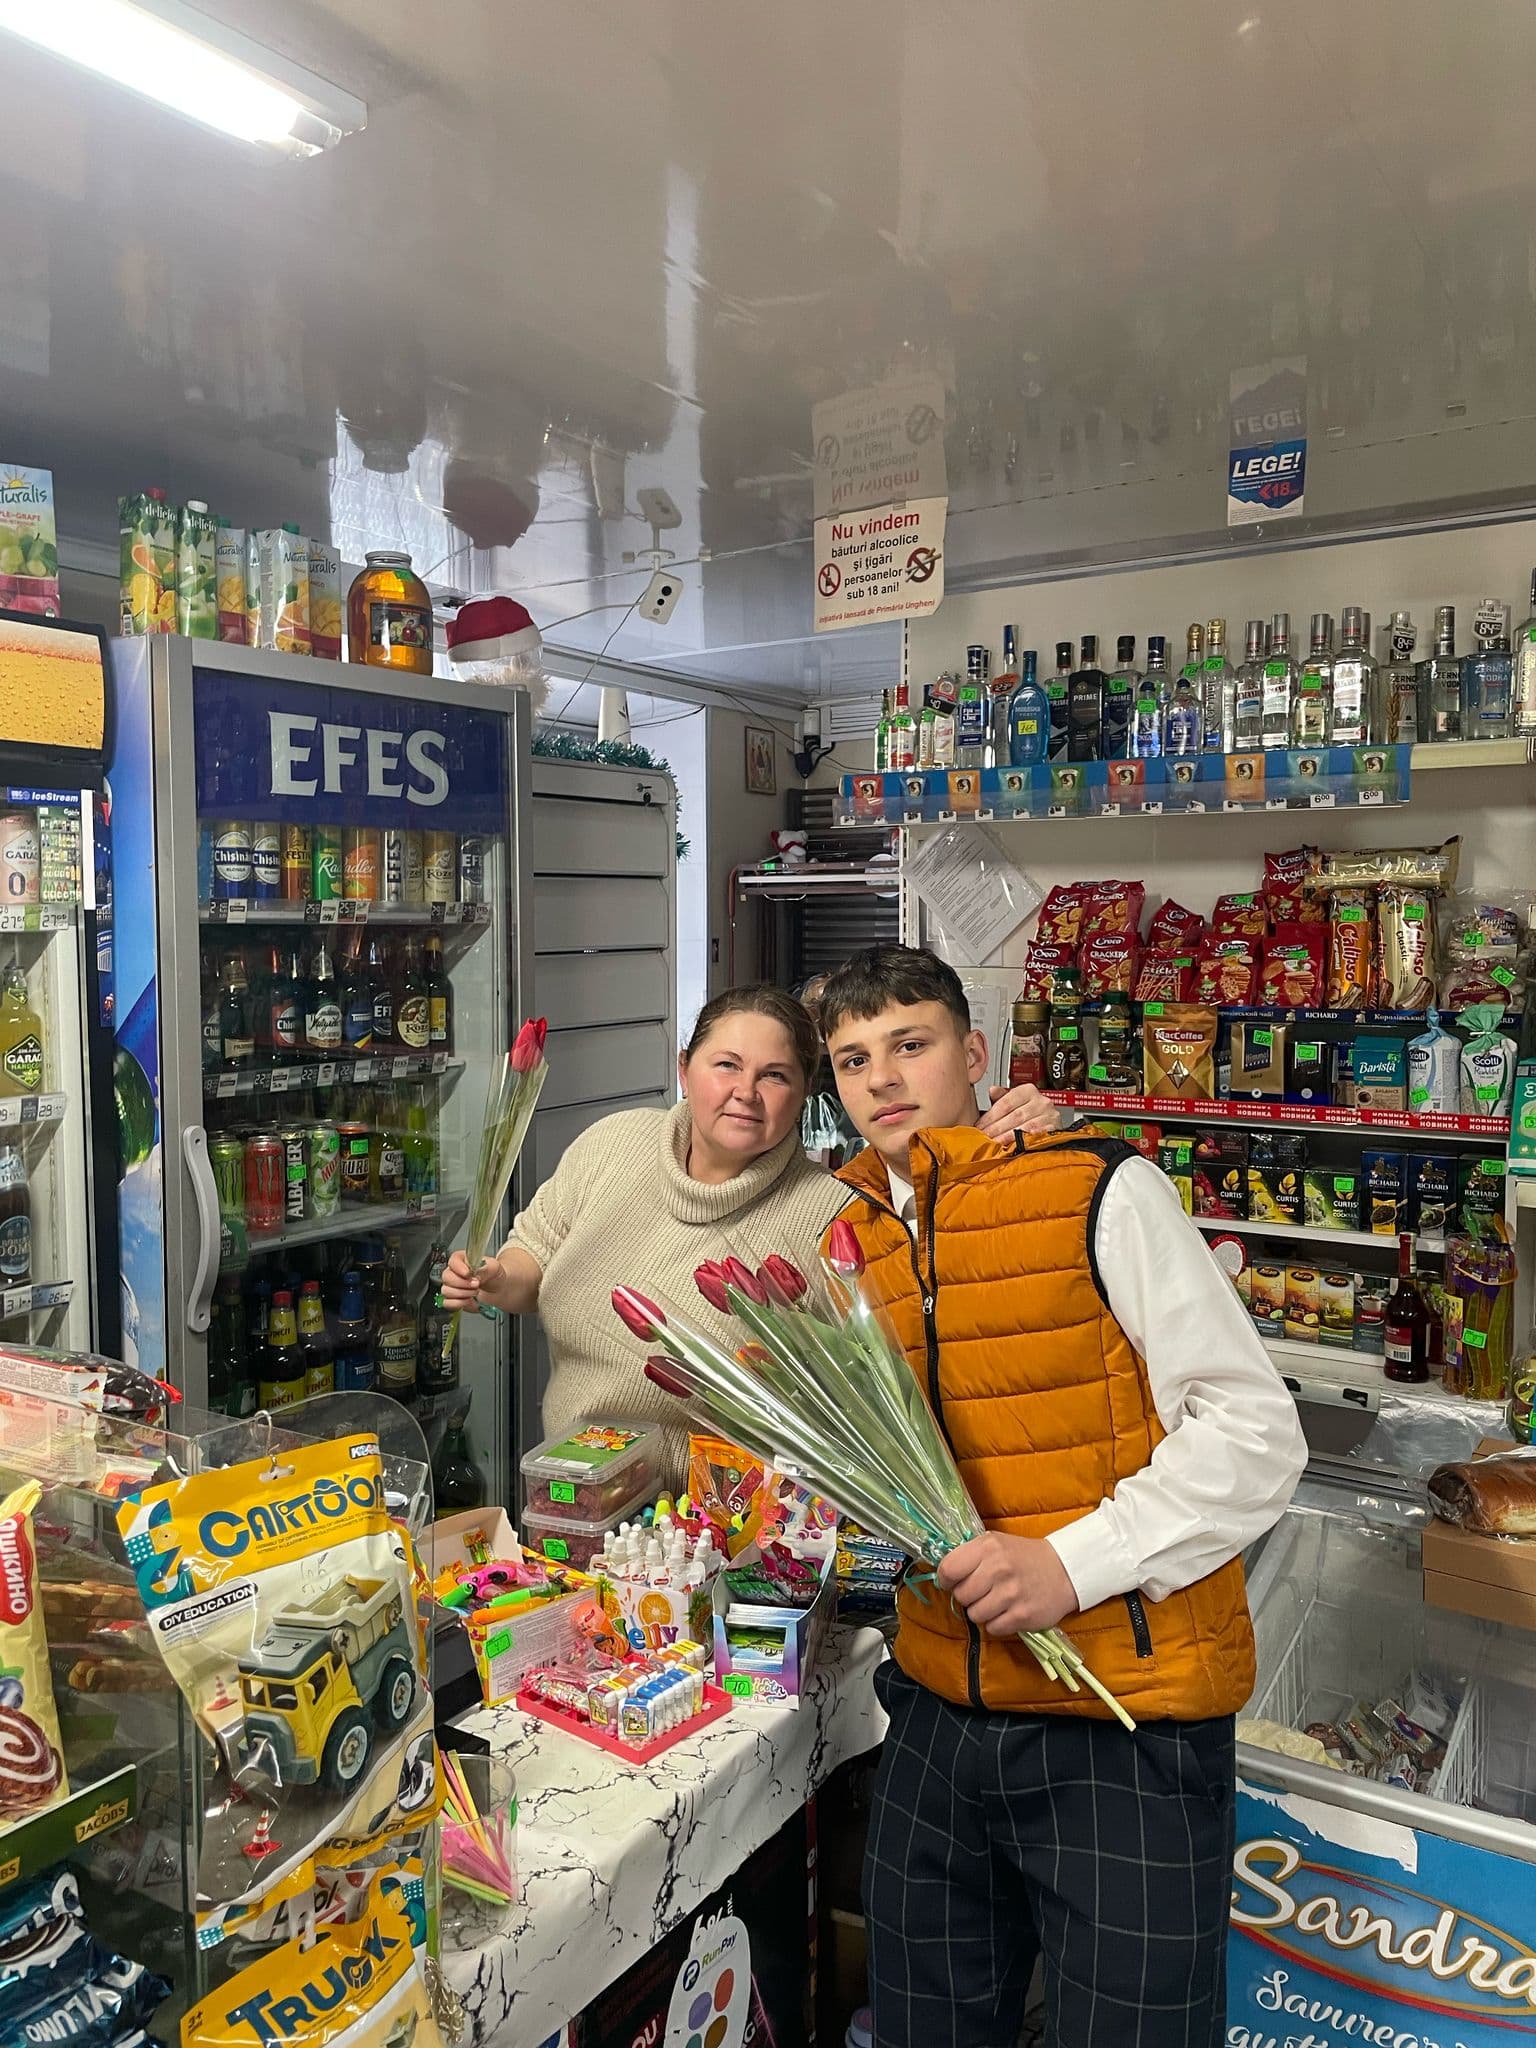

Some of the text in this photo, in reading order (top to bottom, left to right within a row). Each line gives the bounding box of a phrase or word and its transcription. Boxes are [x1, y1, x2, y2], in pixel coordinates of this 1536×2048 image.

[1232, 452, 1301, 478] LEGE!
[0, 480, 48, 504] turalis
[832, 513, 919, 541] Nu vindem
[870, 535, 918, 551] alcoolice
[844, 568, 903, 588] persoanelor
[847, 582, 899, 600] sub 18 ani!
[268, 711, 450, 807] EFES
[31, 791, 79, 802] IceStream
[343, 858, 376, 874] adler
[426, 868, 452, 880] Koze
[1305, 1011, 1338, 1020] RICHARD
[1155, 1029, 1203, 1041] MacCoffee
[1162, 1045, 1194, 1054] GOLD
[1052, 1051, 1065, 1079] GOLD
[1474, 1055, 1500, 1066] Scotti
[1359, 1061, 1397, 1074] Barista
[1113, 1102, 1145, 1110] НОВИНКА
[1153, 1104, 1186, 1112] НОВИНКА
[1194, 1107, 1228, 1115] НОВИНКА
[1237, 1109, 1272, 1118] НОВИНКА
[1280, 1112, 1317, 1121] НОВИНКА
[1325, 1114, 1363, 1124] НОВИНКА
[1371, 1117, 1410, 1127] НОВИНКА
[1419, 1120, 1460, 1130] НОВИНКА
[1469, 1122, 1510, 1132] НОВИНКА
[341, 1159, 369, 1175] TURB
[1416, 1182, 1449, 1190] RICHARD
[1220, 1190, 1243, 1199] CURTIS
[1275, 1195, 1300, 1203] CURTIS
[1464, 1189, 1500, 1198] RICHARD
[1333, 1200, 1358, 1209] CURTIS
[305, 1375, 331, 1395] FINCH
[265, 1393, 294, 1407] FINCH
[164, 1611, 184, 1630] DIY
[184, 1585, 254, 1620] EDUCATION
[79, 1803, 126, 1838] JACOBS
[702, 1931, 738, 1968] RunPay
[226, 1918, 400, 2048] TRUCK
